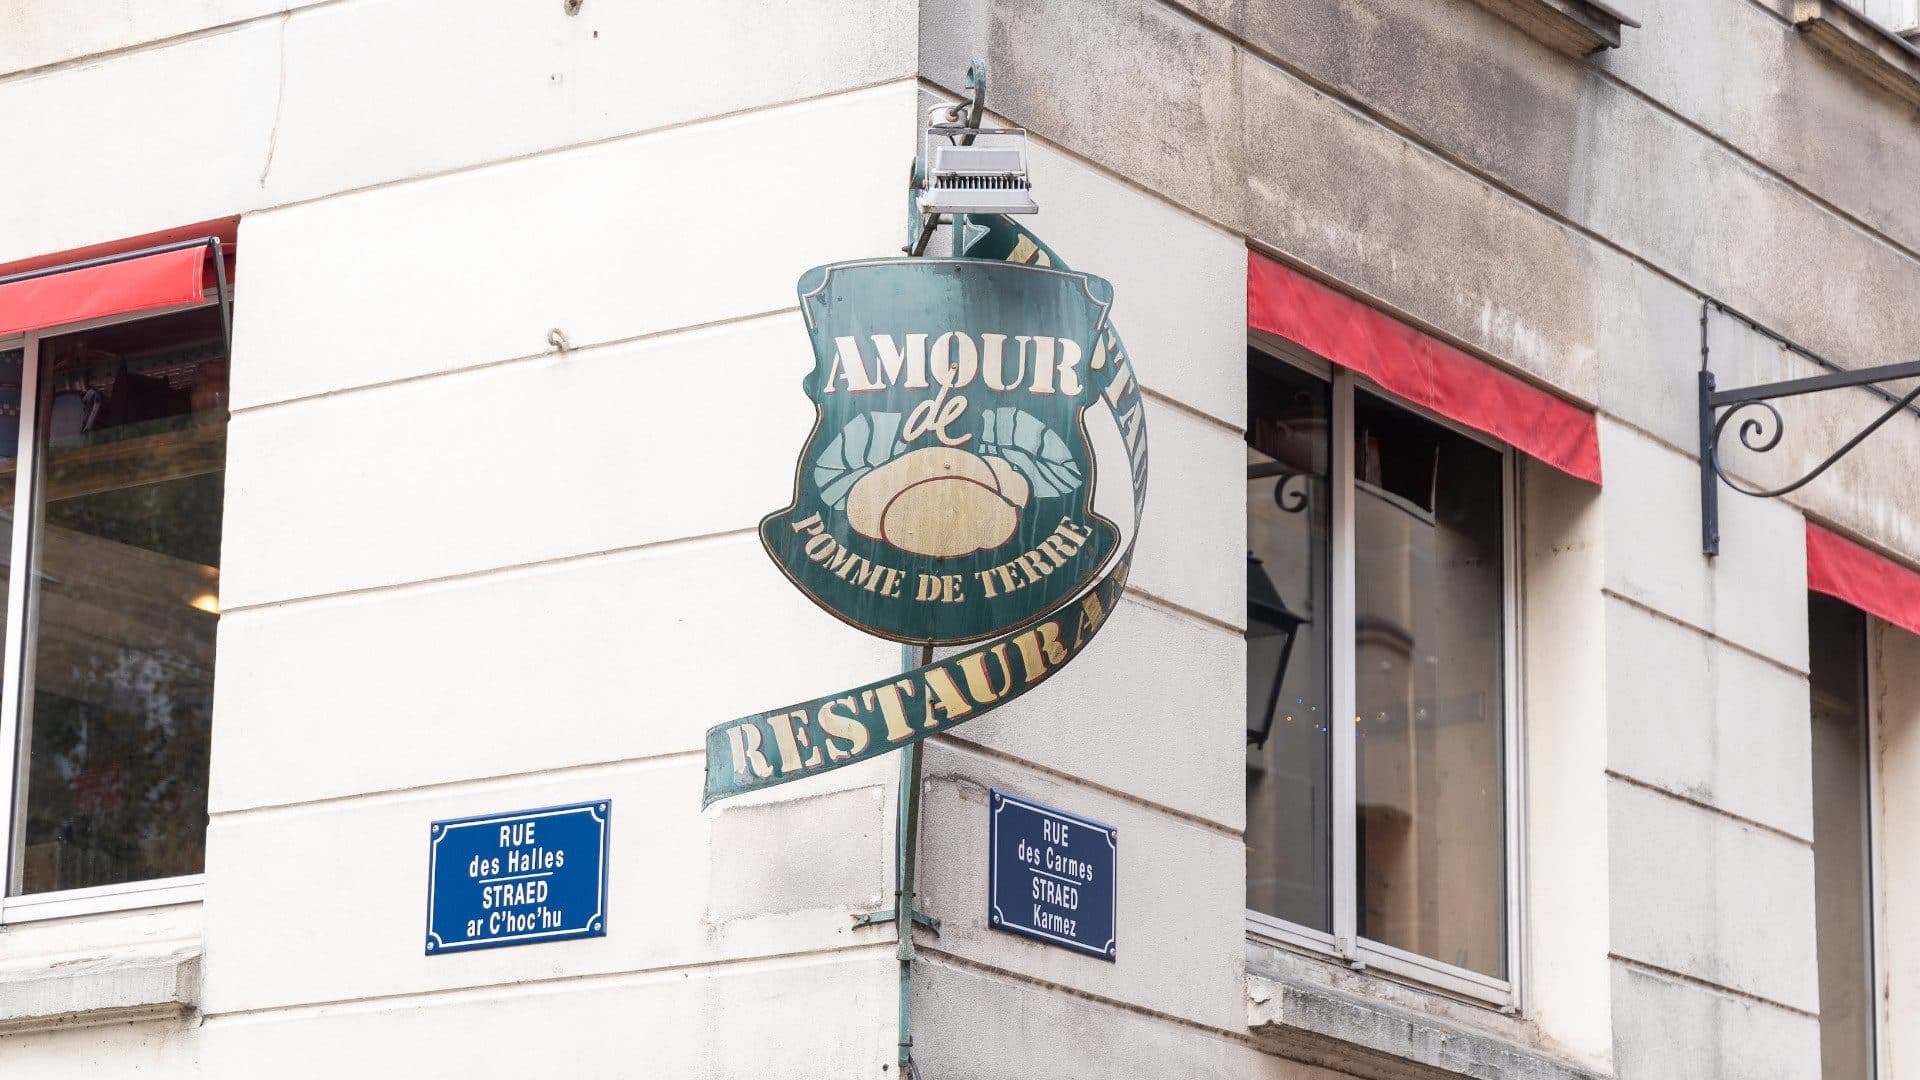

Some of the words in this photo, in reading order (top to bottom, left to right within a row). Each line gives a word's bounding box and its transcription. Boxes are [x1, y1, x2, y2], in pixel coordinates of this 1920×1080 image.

[823, 330, 1084, 396] AMOUR
[902, 363, 974, 447] de
[791, 512, 906, 599] POMME
[914, 574, 966, 604] DE
[974, 515, 1094, 599] TERRE
[727, 559, 1129, 779] RESTAURA
[499, 822, 536, 848] RUE
[1043, 818, 1070, 848] RUE
[469, 854, 500, 878] des
[508, 847, 565, 873] Halles
[1018, 838, 1041, 866] des
[1045, 846, 1094, 882] Carmes
[481, 879, 549, 910] STRAED
[1031, 876, 1079, 911] STRAED
[466, 917, 484, 937] ar
[489, 906, 562, 935] C'hoc'hu
[1033, 903, 1077, 937] Karmez
